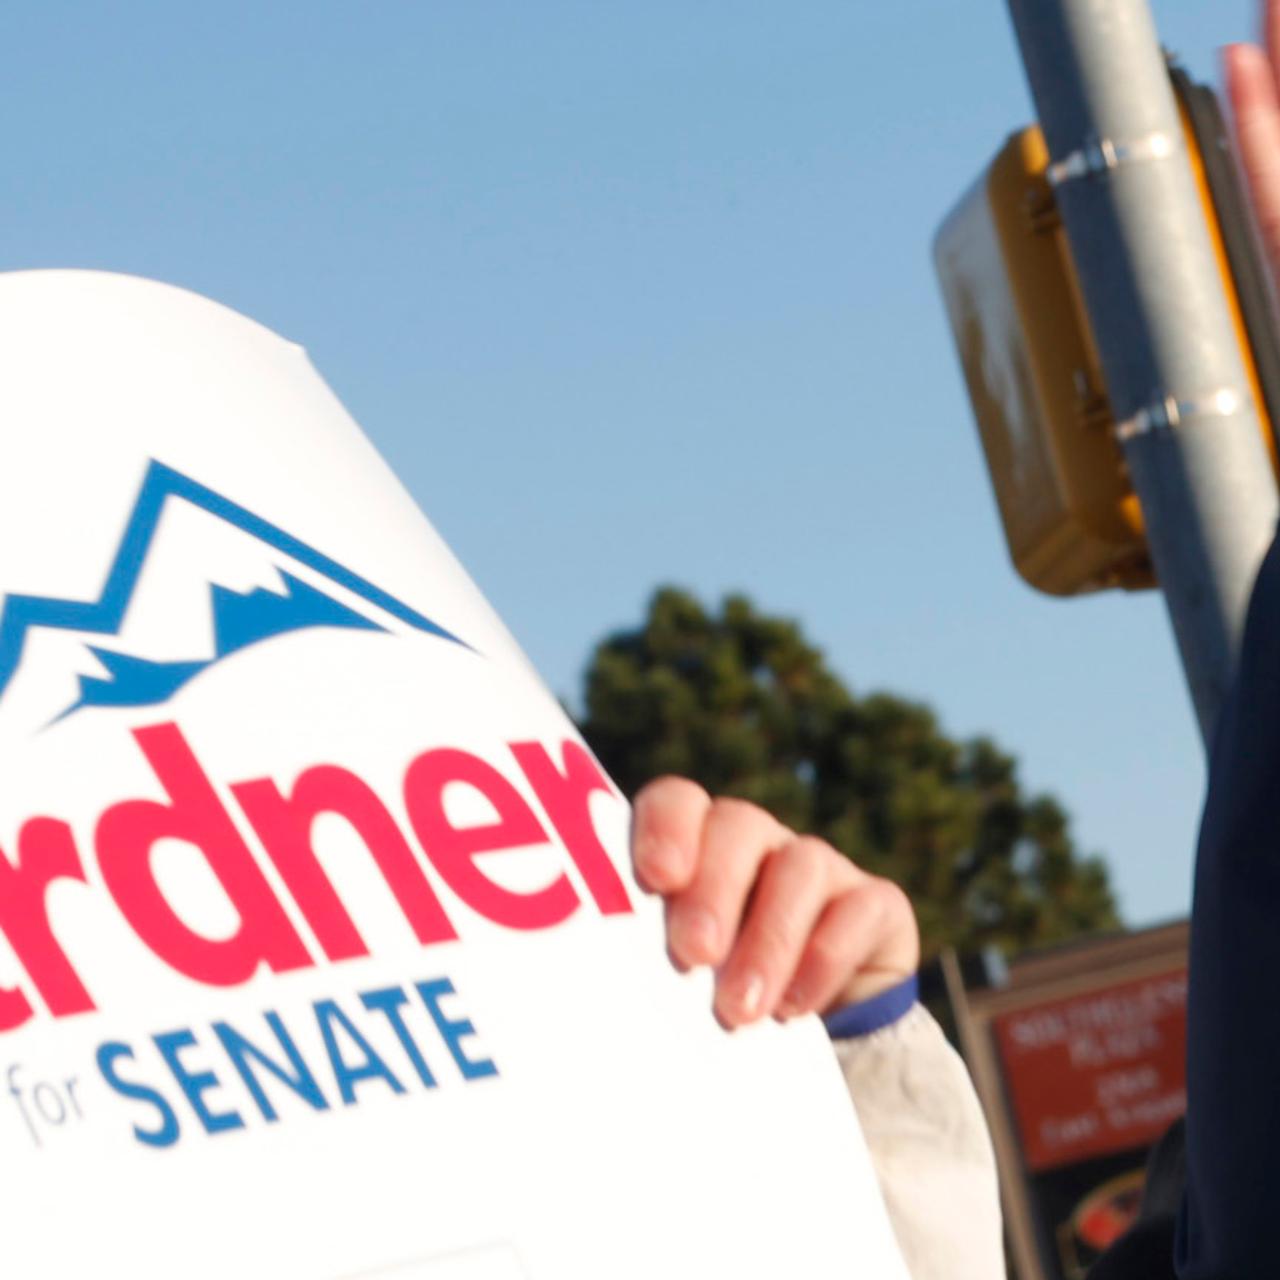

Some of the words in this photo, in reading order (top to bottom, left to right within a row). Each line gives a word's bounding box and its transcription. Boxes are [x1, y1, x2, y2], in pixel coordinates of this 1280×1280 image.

[0, 719, 635, 1033] rdner
[5, 1062, 84, 1147] for
[95, 976, 500, 1148] SENATE
